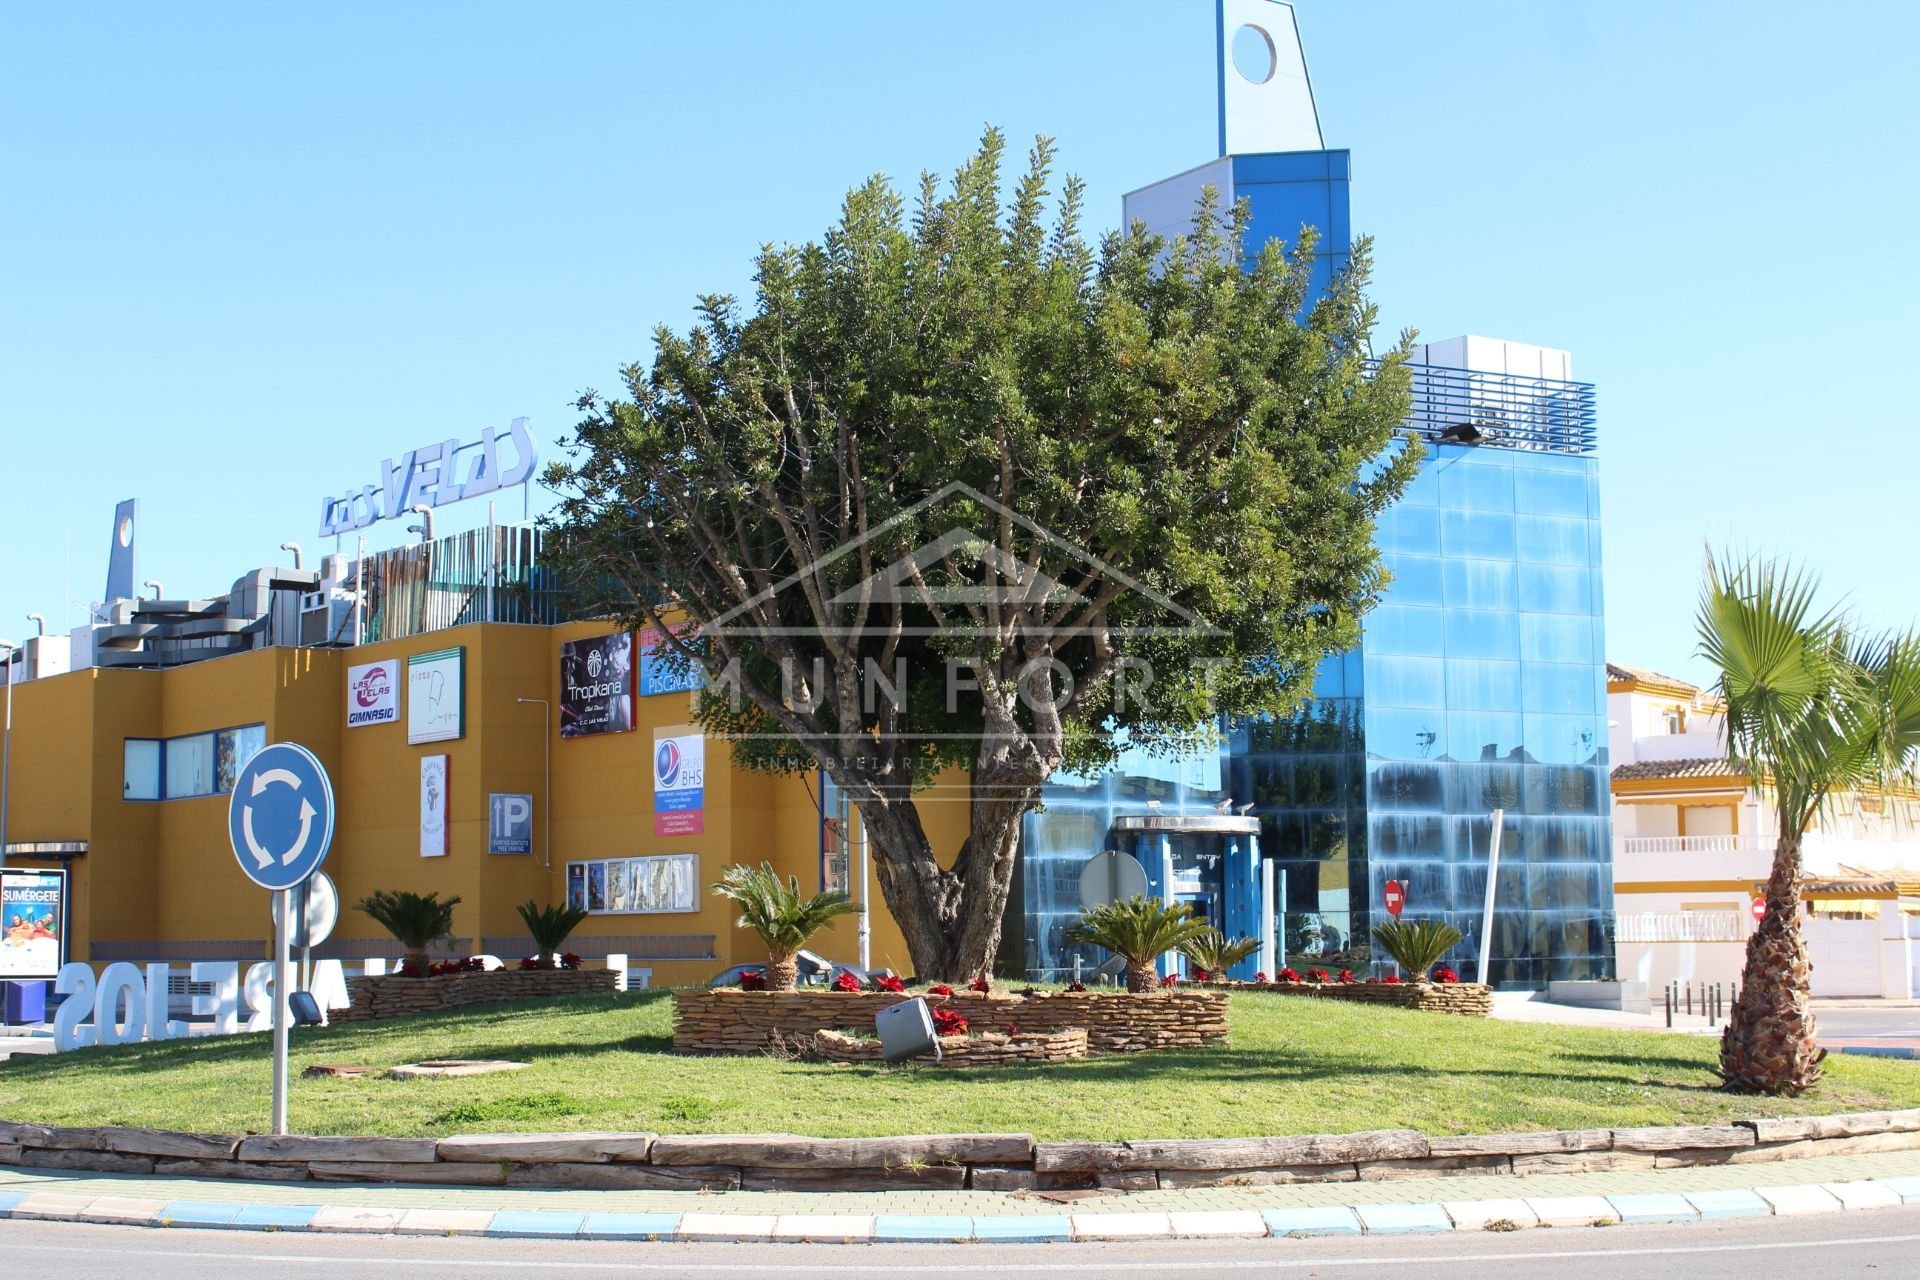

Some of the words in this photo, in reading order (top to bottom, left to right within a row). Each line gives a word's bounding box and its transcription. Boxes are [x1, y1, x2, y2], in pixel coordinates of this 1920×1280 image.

[319, 484, 378, 538] LAS
[381, 416, 539, 520] VELAS
[352, 680, 370, 690] LAS
[648, 672, 694, 695] PISCINAS
[349, 707, 394, 724] GIMNASIO
[682, 769, 702, 786] BHS
[504, 797, 529, 838] P
[3, 887, 59, 902] SUMÉRGETE
